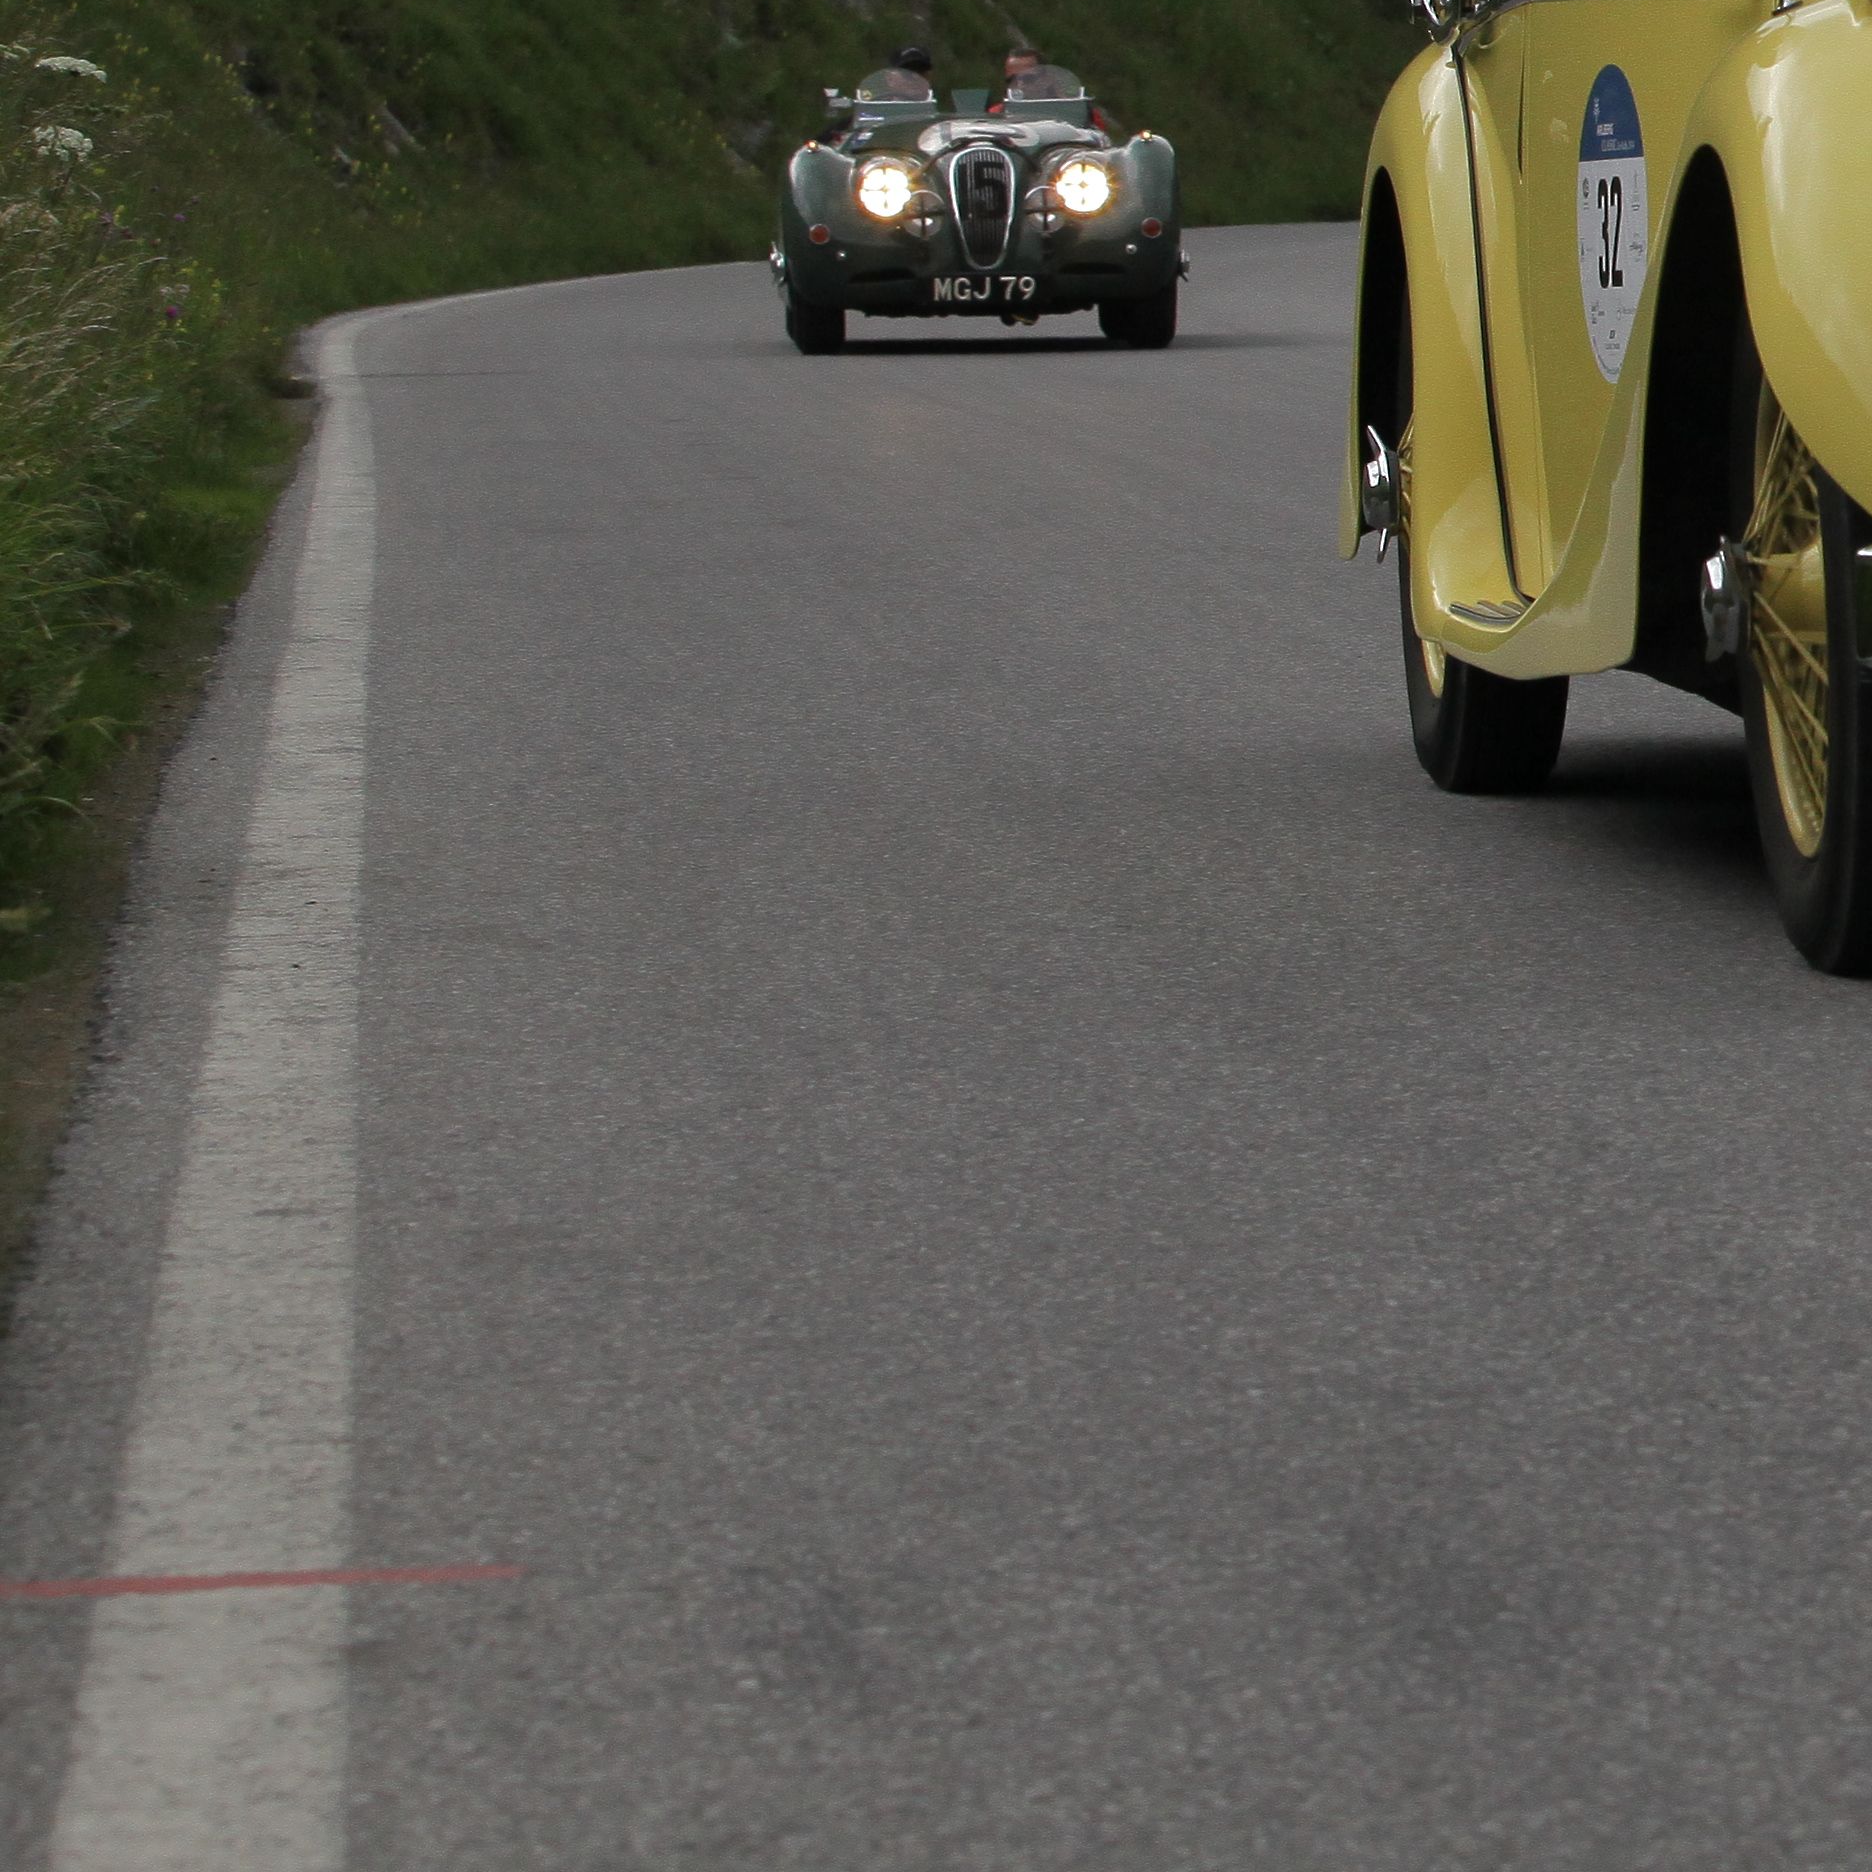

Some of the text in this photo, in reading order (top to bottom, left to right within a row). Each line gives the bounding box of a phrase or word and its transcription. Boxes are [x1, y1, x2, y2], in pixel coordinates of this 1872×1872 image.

[1597, 175, 1624, 289] 32
[934, 275, 1036, 302] MGJ 79
